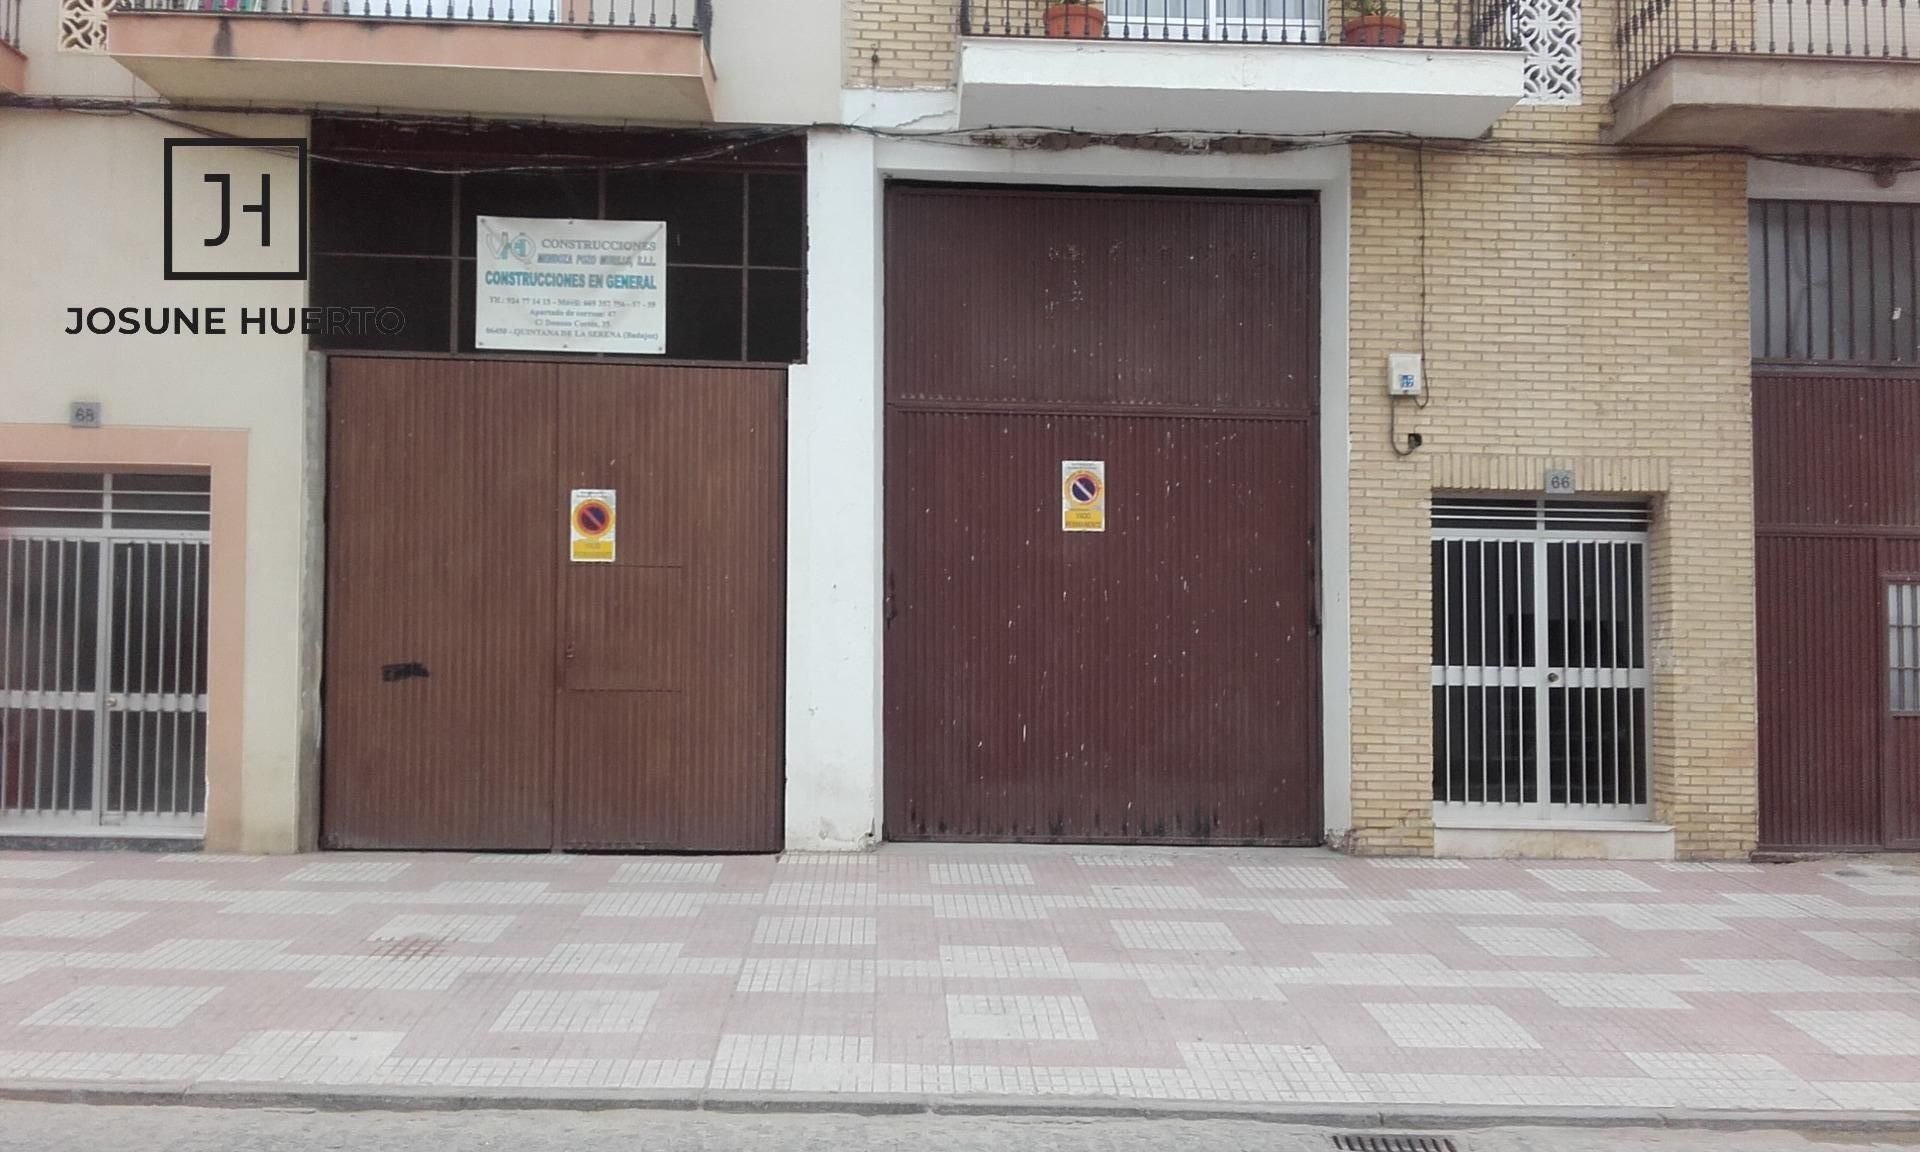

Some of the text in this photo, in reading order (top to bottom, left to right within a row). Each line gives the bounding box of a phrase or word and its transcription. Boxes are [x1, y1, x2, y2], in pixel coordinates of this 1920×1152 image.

[541, 238, 657, 252] CONSTRUCCIONES
[485, 270, 657, 290] CONSTRUCCIONES EN GENERAL
[514, 328, 560, 337] QUINTANA
[561, 329, 573, 337] DE
[575, 330, 586, 338] LA
[588, 330, 622, 339] SERENA
[1551, 475, 1570, 489] 66
